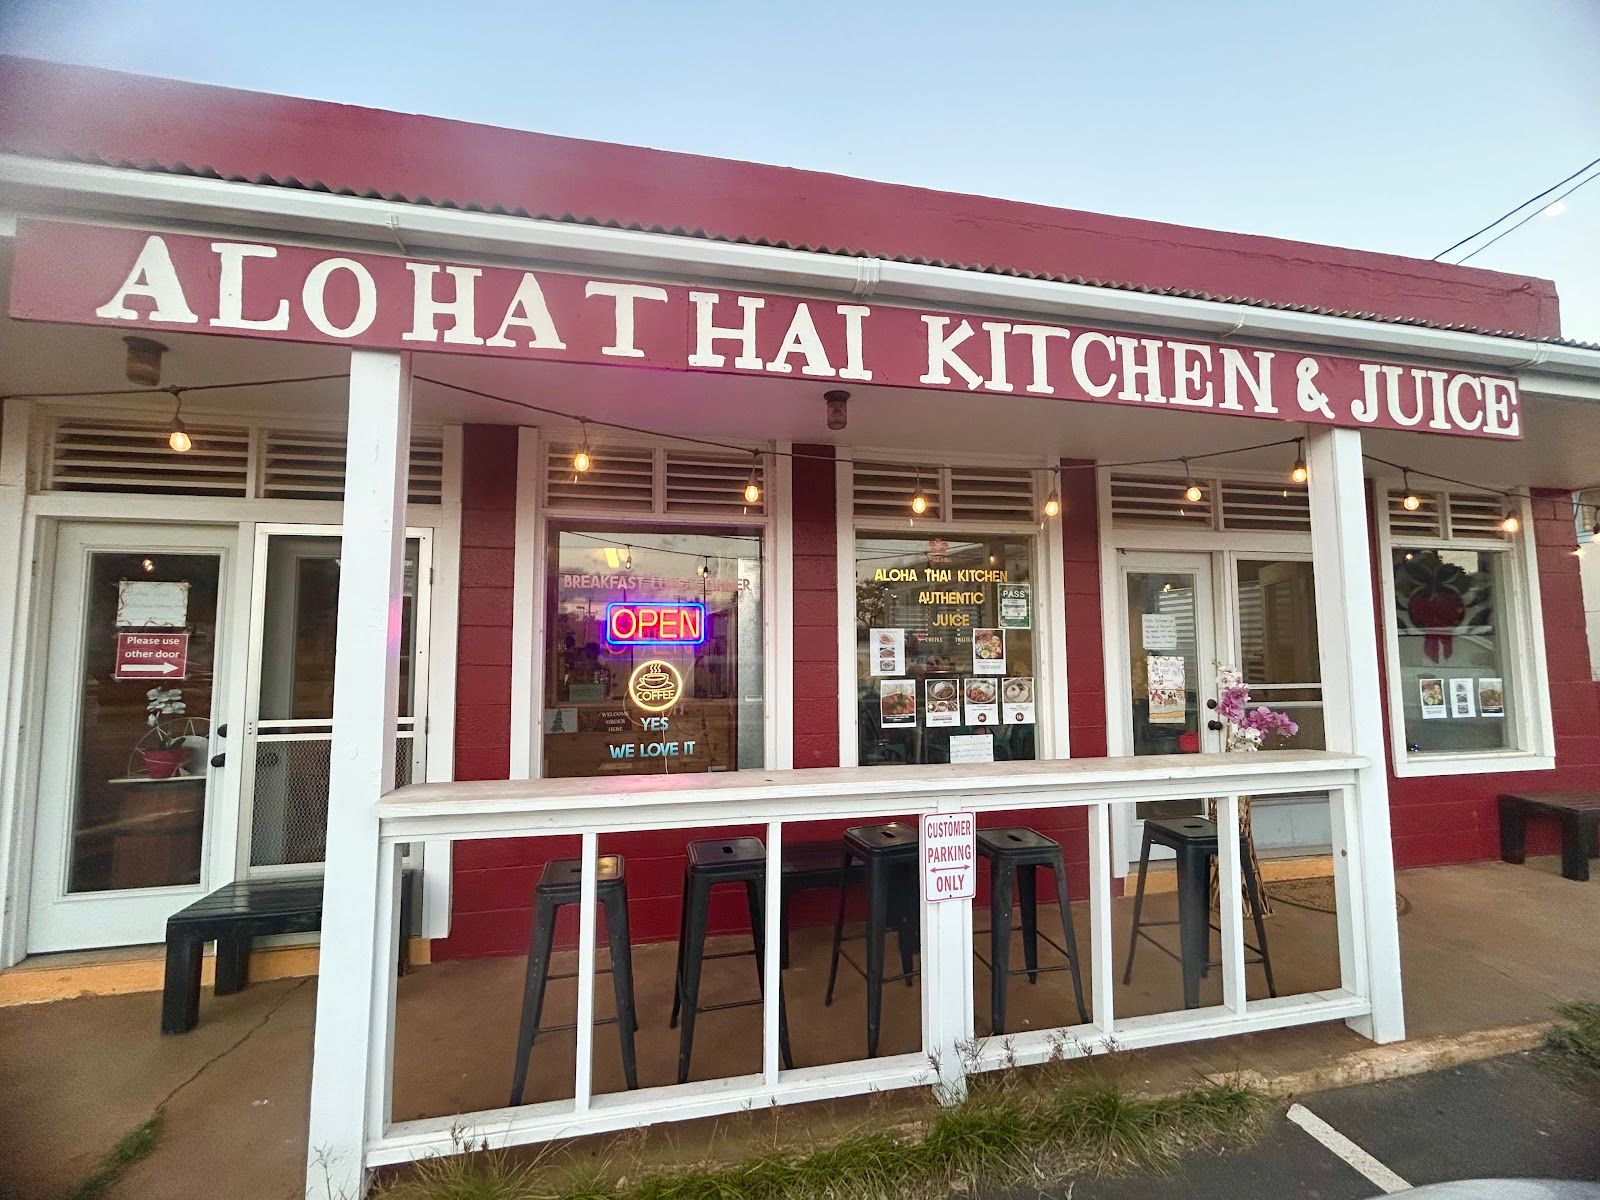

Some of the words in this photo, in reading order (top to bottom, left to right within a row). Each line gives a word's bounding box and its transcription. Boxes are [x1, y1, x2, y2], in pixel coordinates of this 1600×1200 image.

[95, 235, 567, 350] ALOHA
[585, 280, 873, 381] THAI
[919, 314, 1278, 415] KITCHEN
[1296, 357, 1335, 420] &
[1351, 363, 1522, 438] JUICE
[564, 574, 643, 589] BREAKFAST
[874, 568, 918, 582] ALOHA
[924, 568, 951, 582] THAI
[957, 569, 1008, 583] KITCHEN
[918, 591, 984, 605] AUTHENTIC
[1003, 590, 1025, 598] PASS
[611, 608, 700, 639] OPEN
[932, 613, 970, 627] JUICE
[127, 636, 160, 645] Please
[124, 650, 153, 658] other
[155, 650, 180, 658] door
[636, 689, 676, 701] COFFEE
[640, 717, 669, 732] YES
[609, 743, 635, 759] WE
[640, 742, 679, 757] LOVE
[683, 741, 696, 755] IT
[927, 820, 971, 839] CUSTOMER
[928, 844, 971, 864] PARKING
[936, 874, 965, 893] ONLY
